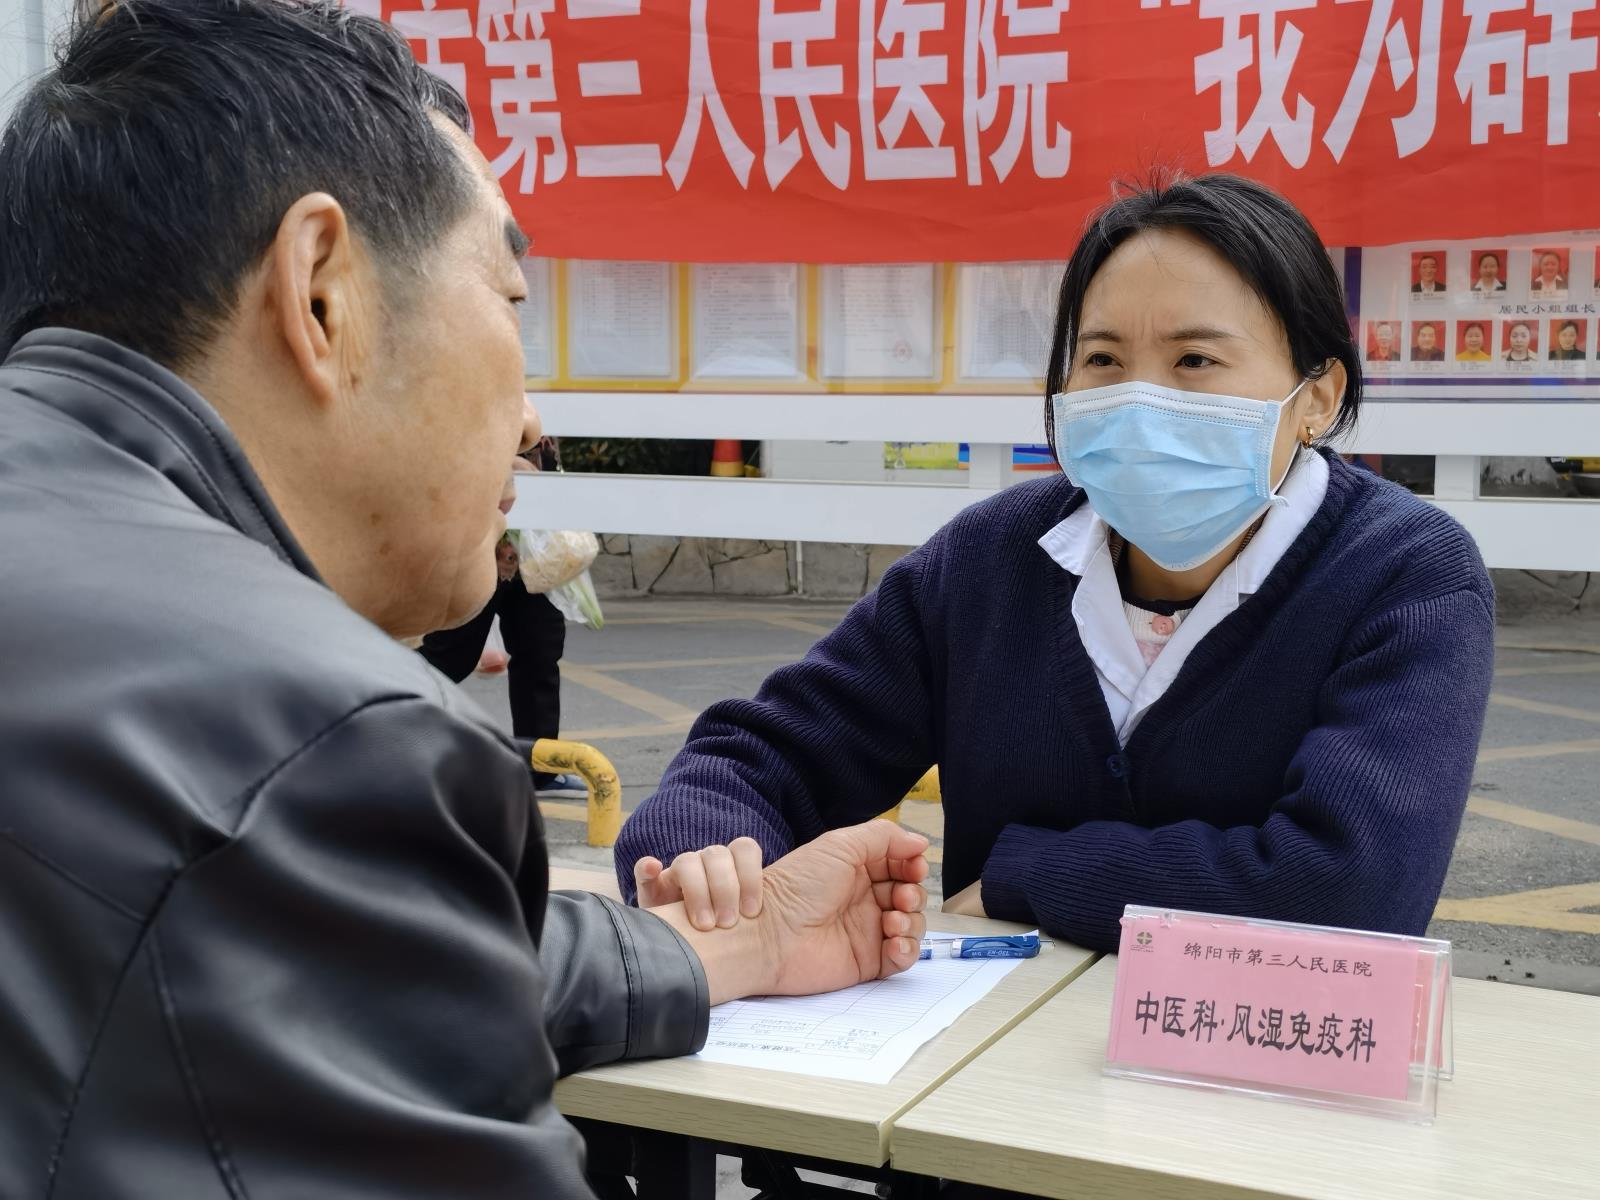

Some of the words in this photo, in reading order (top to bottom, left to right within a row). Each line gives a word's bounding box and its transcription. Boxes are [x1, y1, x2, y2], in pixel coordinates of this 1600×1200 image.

[1141, 0, 1599, 170] 我为群
[1498, 303, 1596, 314] 居民小组组长
[1183, 942, 1373, 977] 绵阳市第三人民医院
[1135, 991, 1377, 1063] 中医科·风湿免疫科
